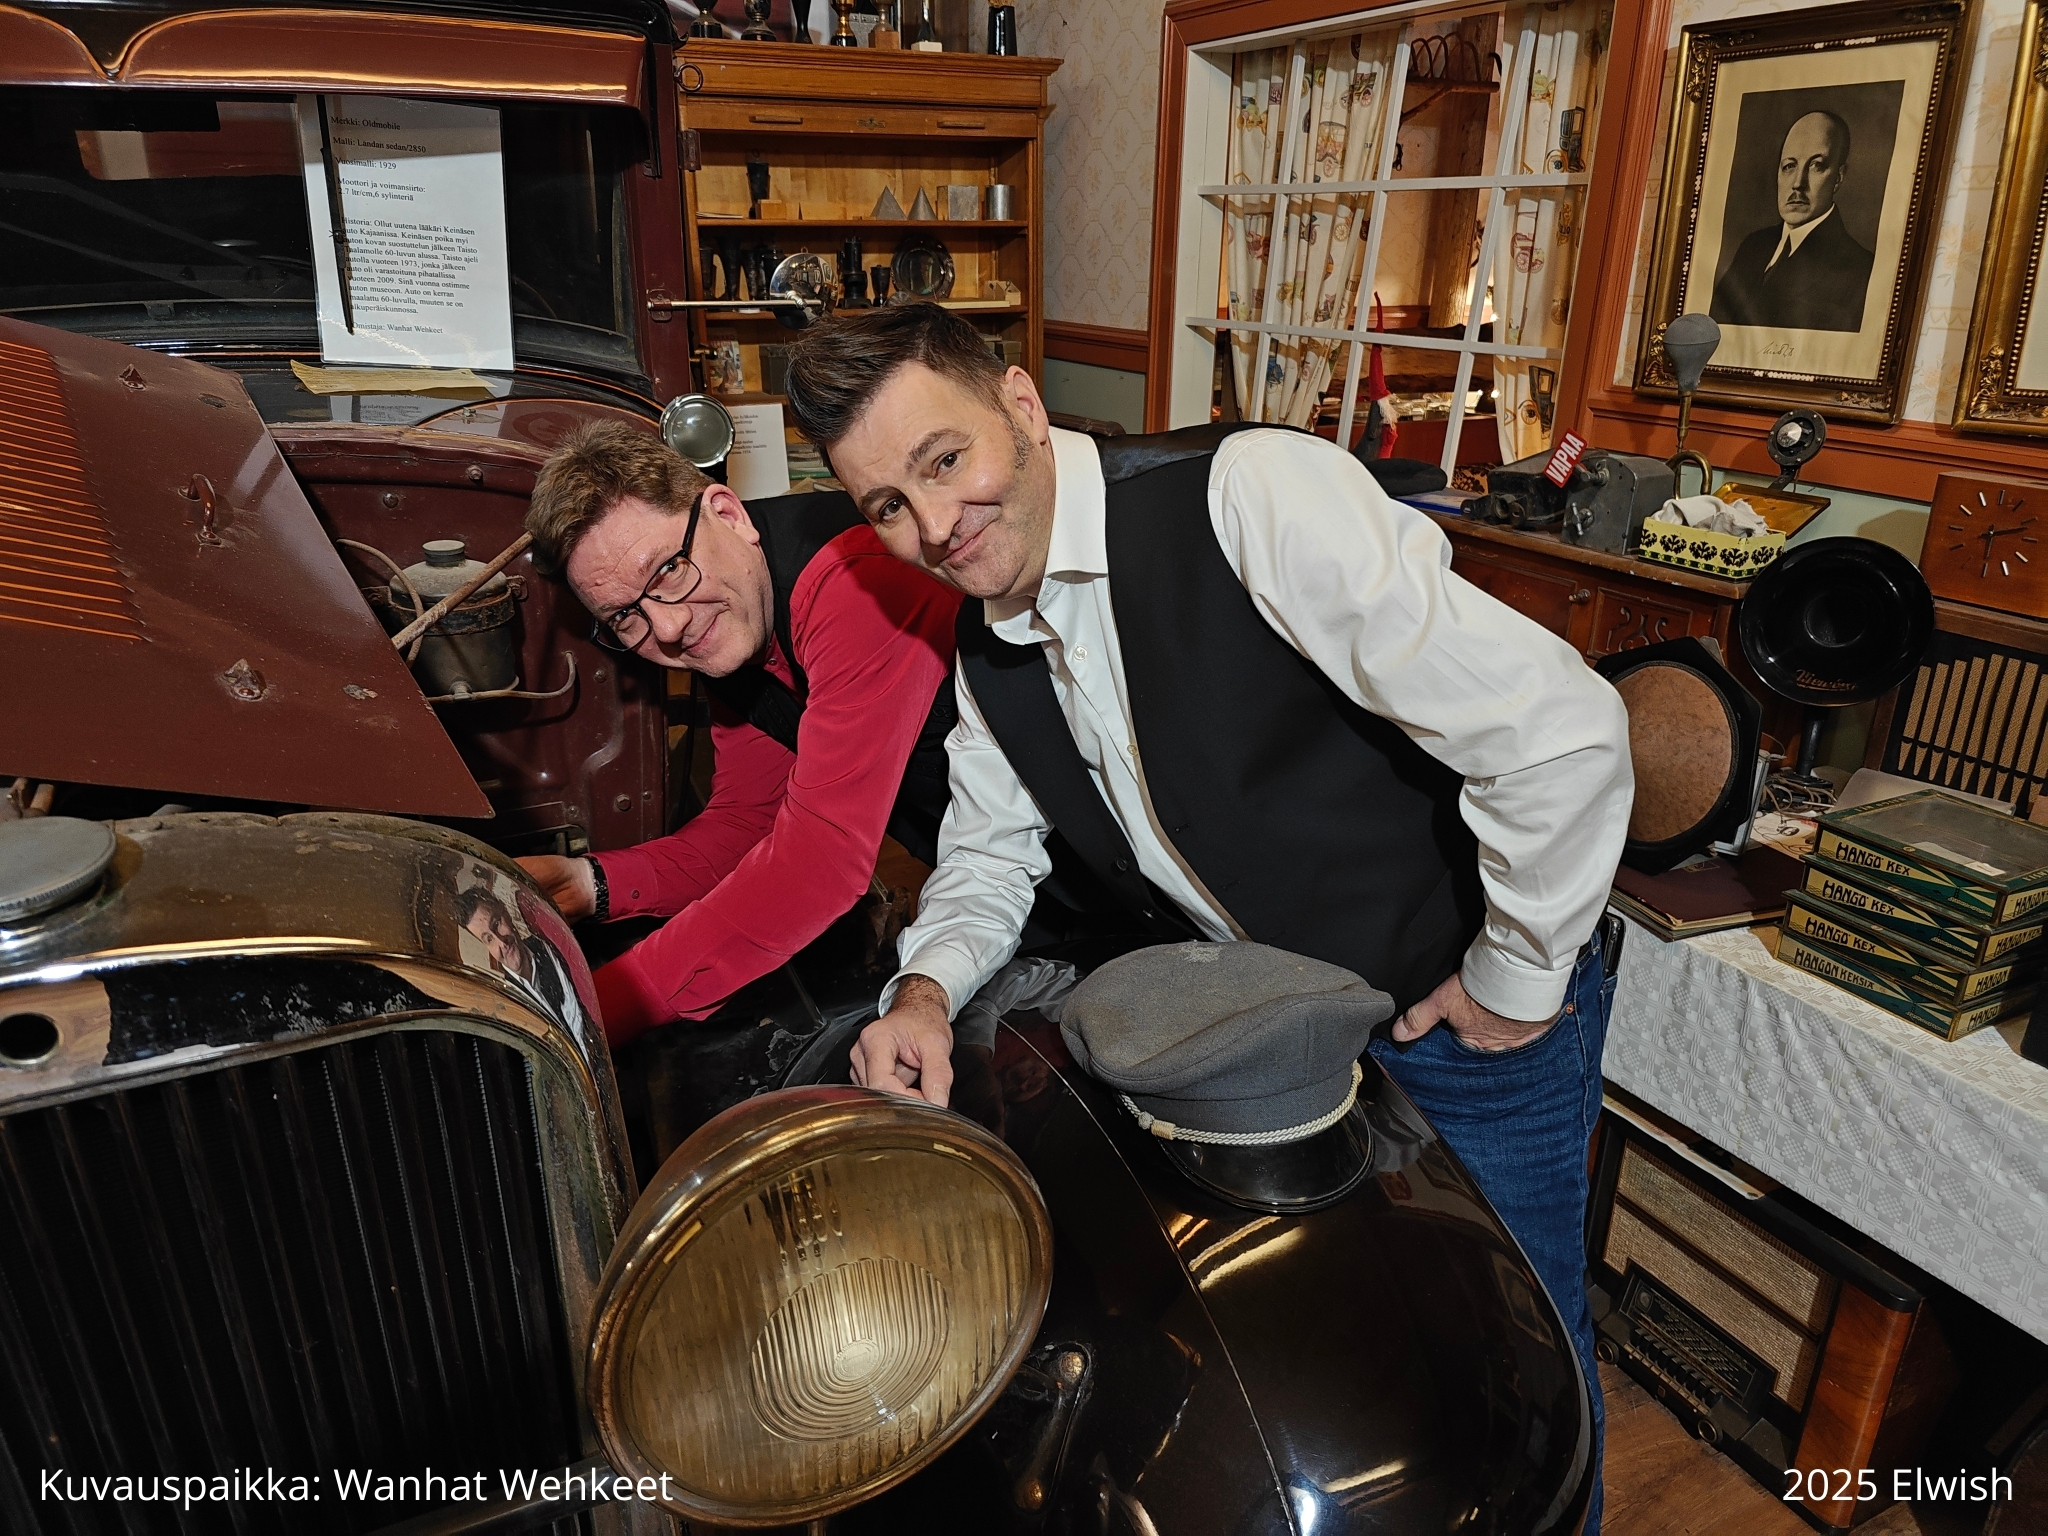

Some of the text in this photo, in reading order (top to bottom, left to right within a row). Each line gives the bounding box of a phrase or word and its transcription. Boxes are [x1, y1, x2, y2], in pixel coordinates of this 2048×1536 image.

[331, 117, 401, 131] Merkki: Oldmobile
[333, 137, 355, 146] Malli:
[386, 142, 426, 153] sedan/2850
[335, 157, 397, 170] Vuosimalli: 1929
[370, 180, 378, 189] ja
[380, 182, 426, 193] voimansiirto:
[374, 220, 393, 228] Ollut
[360, 228, 399, 238] Kajaanissa.
[401, 230, 433, 241] Keinäsen
[434, 234, 455, 244] poika
[455, 237, 469, 245] myi
[365, 237, 387, 246] kovan
[388, 240, 430, 250] suostuttelun
[431, 244, 456, 252] jälkeen
[457, 245, 478, 254] Taisto
[385, 248, 416, 258] 60-luvun
[417, 252, 440, 260] alussa.
[441, 253, 463, 262] Taisto
[463, 256, 479, 264] ajeli
[371, 257, 399, 266] vuoteen
[401, 259, 420, 268] 1973,
[420, 261, 441, 270] jonka
[441, 263, 466, 271] jälkeen
[375, 268, 417, 277] varastoituna
[418, 270, 456, 280] pihatallissa
[348, 275, 376, 283] vuoteen
[377, 276, 396, 284] 2009.
[397, 277, 414, 286] Sinä
[441, 281, 470, 290] ostimme
[350, 294, 379, 302] maalattu
[380, 296, 418, 305] 60-luvulla,
[404, 287, 421, 295] Auto
[433, 290, 455, 298] kerran
[387, 323, 412, 332] Wanhat
[414, 324, 444, 334] Wehkeet
[1545, 432, 1585, 484] VAPAA
[1886, 860, 1911, 876] KEX
[1870, 899, 1895, 916] KEX
[1852, 936, 1877, 953] KEX
[1793, 947, 1840, 977] HANGON
